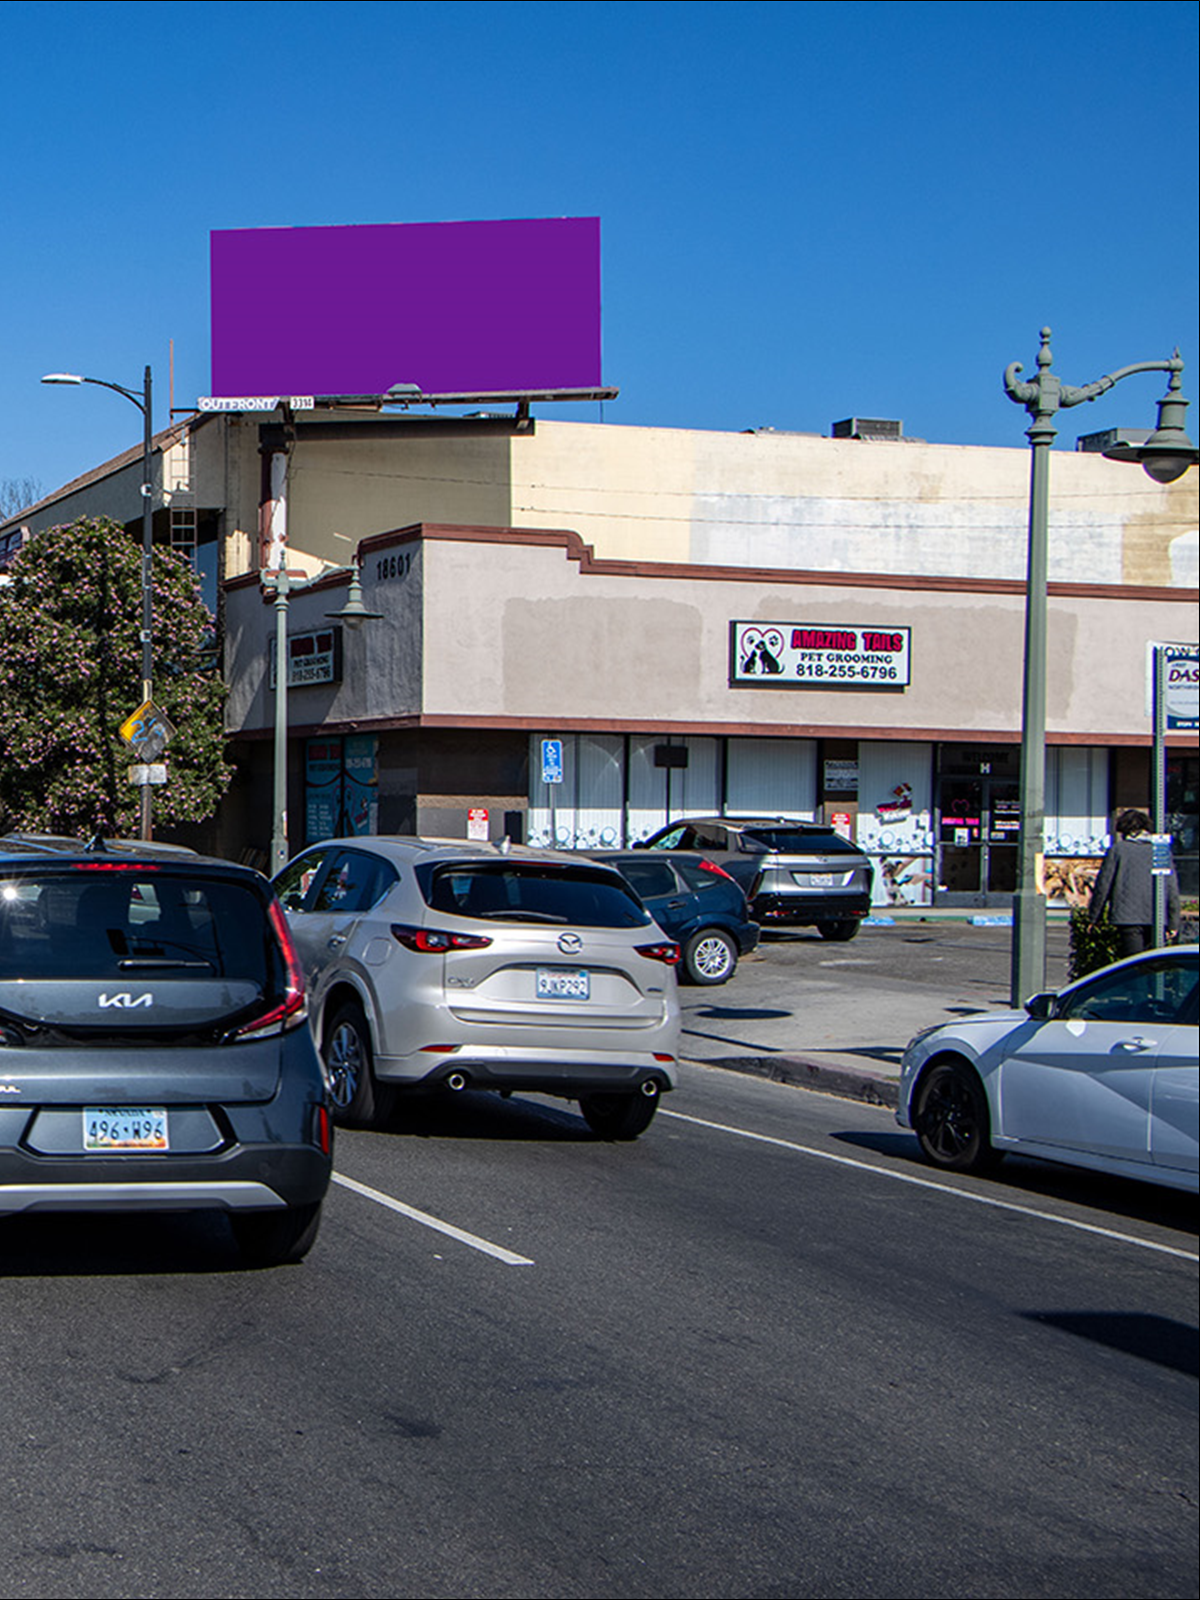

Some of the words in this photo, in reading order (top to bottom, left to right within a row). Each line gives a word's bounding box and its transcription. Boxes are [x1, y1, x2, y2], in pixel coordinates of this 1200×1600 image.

[201, 400, 273, 410] OUTFRONT
[376, 552, 411, 581] 18601
[791, 629, 857, 649] AMAZING
[862, 632, 903, 652] TAILS
[800, 652, 822, 662] PET
[826, 653, 893, 664] GROOMING
[796, 664, 898, 679] 818-255-6796
[980, 763, 990, 773] H
[98, 993, 153, 1008] KIA
